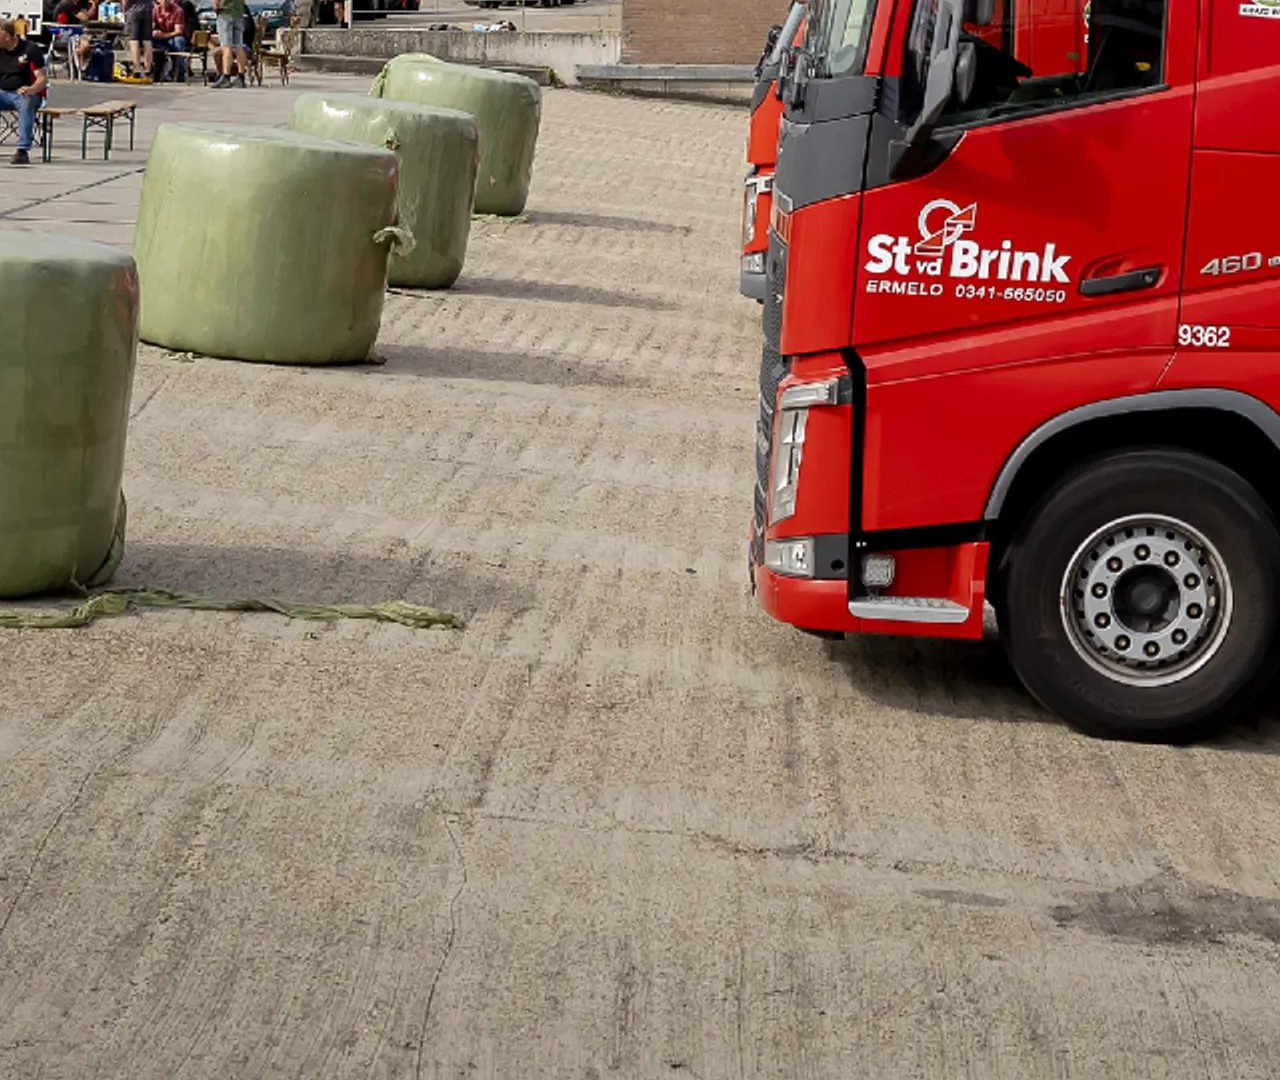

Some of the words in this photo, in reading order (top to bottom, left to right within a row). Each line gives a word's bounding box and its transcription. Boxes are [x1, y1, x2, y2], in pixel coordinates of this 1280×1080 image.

[864, 233, 912, 276] St
[916, 257, 943, 276] vd
[949, 239, 1072, 283] Brink
[1200, 251, 1262, 276] 460
[865, 280, 944, 296] ERMELO
[1178, 324, 1231, 347] 9362
